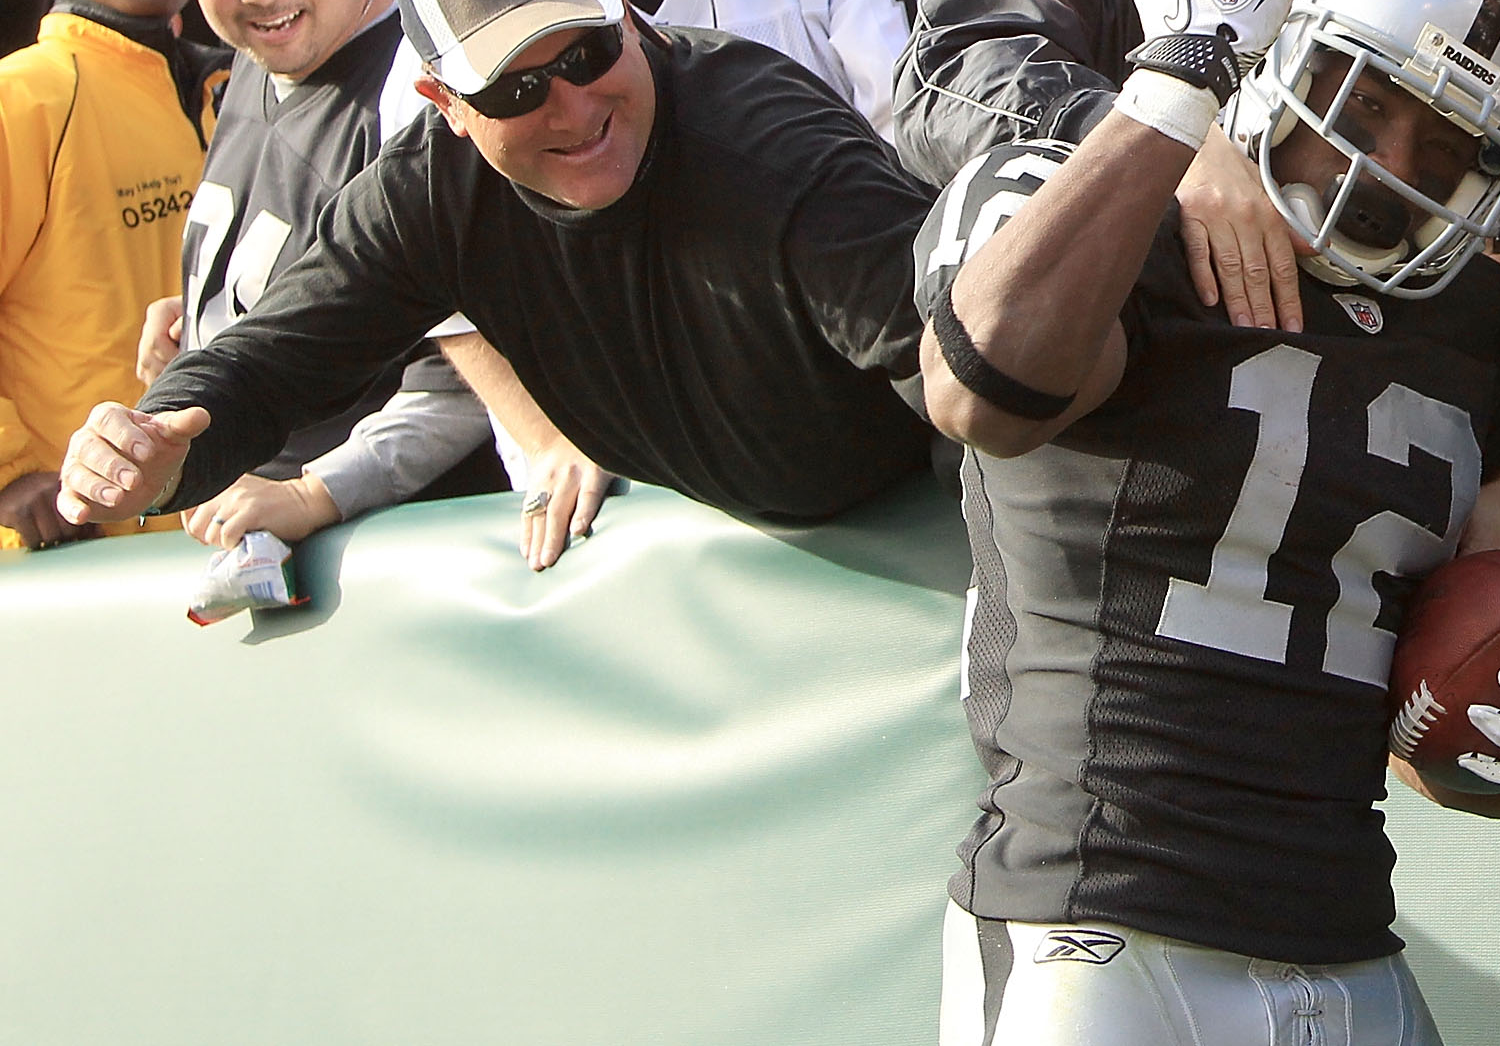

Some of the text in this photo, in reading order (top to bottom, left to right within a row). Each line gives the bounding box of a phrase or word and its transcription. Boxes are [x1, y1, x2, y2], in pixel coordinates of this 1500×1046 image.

[1442, 45, 1496, 86] RAIDERS
[122, 190, 194, 228] 05242
[1155, 343, 1482, 690] 12
